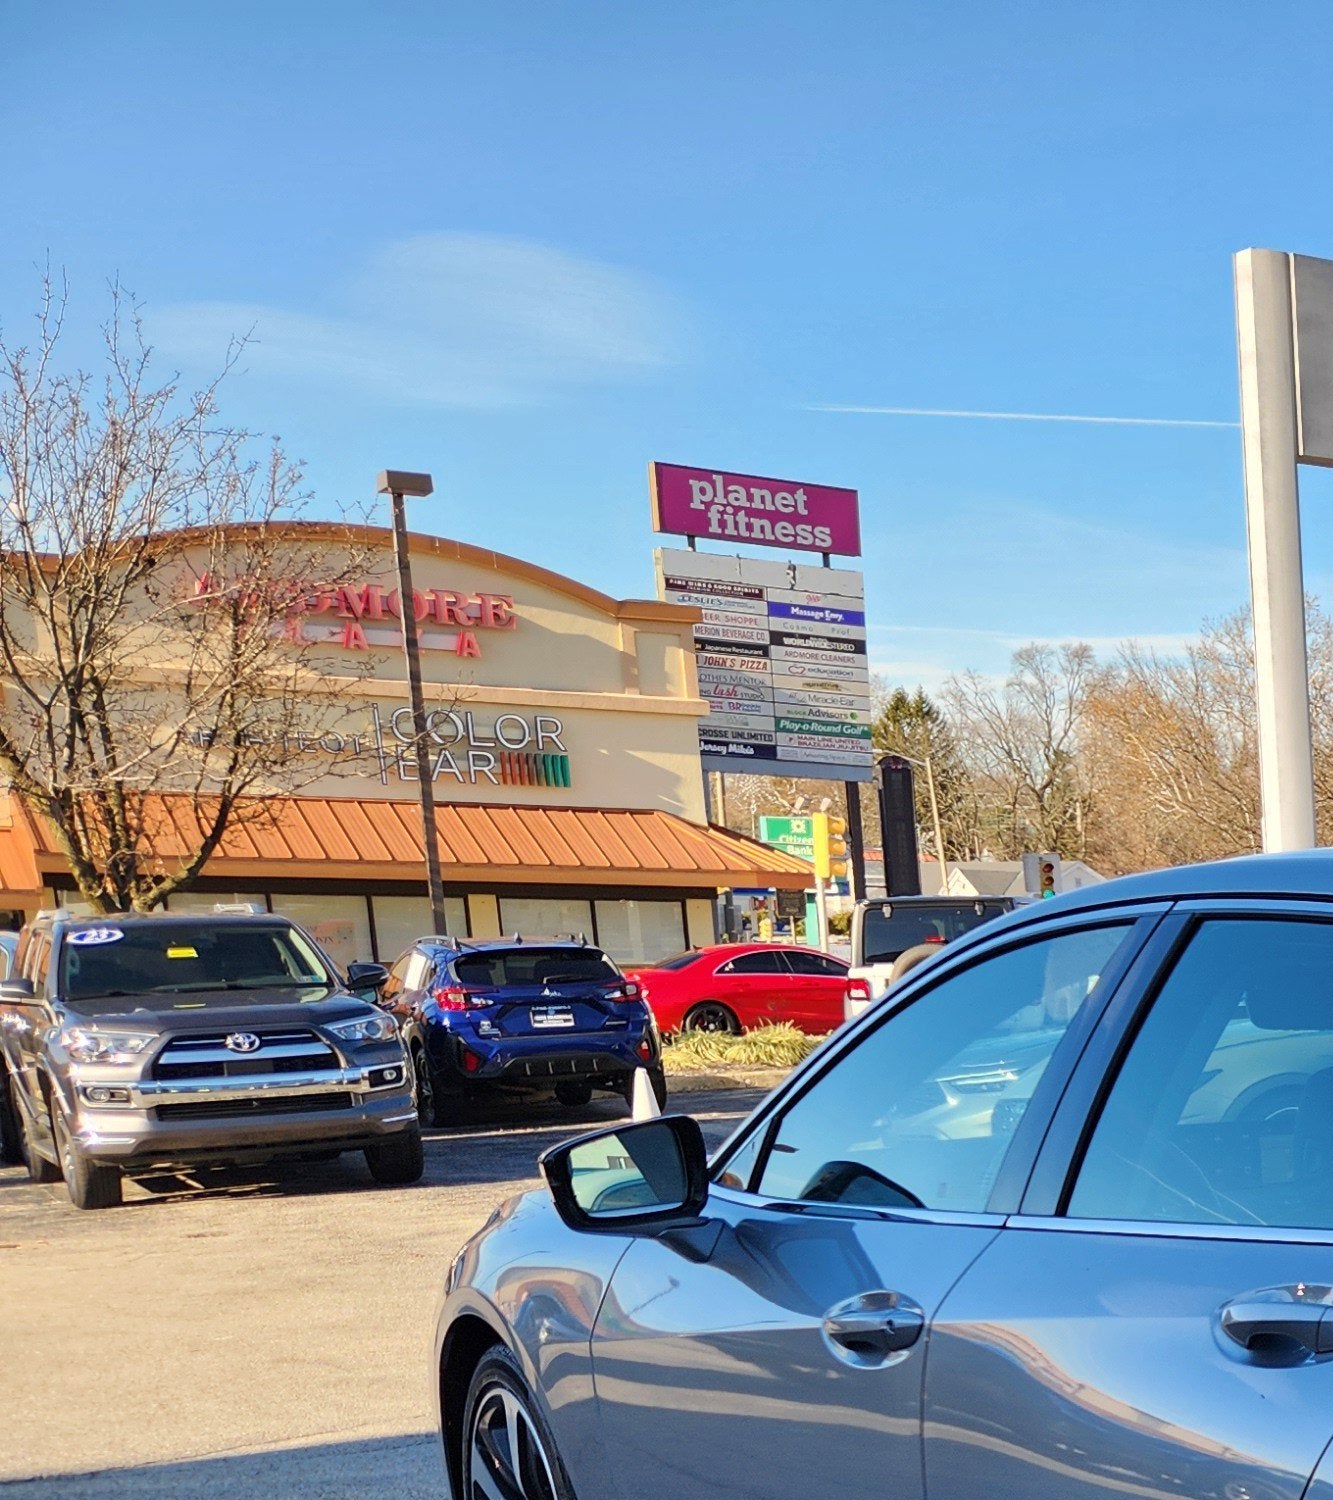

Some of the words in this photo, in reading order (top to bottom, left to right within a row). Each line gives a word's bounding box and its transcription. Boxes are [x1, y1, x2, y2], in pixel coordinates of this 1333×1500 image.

[689, 474, 809, 516] planet
[708, 504, 833, 548] fitness
[702, 613, 720, 622] EER
[725, 615, 759, 626] SHOPPE
[790, 606, 825, 620] Massage
[694, 625, 721, 637] MERION
[721, 628, 755, 641] BEVERAGE
[782, 622, 814, 632] Cosmo
[831, 627, 851, 636] Prof
[704, 643, 732, 652] Japanese
[732, 646, 764, 656] Restaurant
[703, 655, 736, 668] JOHN'S
[740, 659, 768, 671] PIZZA
[784, 650, 818, 661] ARDMORE
[820, 653, 856, 664] CLEANERS
[699, 672, 727, 683] OTHES
[807, 708, 849, 720] Advisors
[391, 706, 568, 753] COLOR
[698, 728, 729, 739] CROSSE
[731, 731, 774, 742] UNLIMITED
[700, 740, 727, 755] Jersey
[728, 743, 755, 755] Mike's
[779, 834, 814, 845] Citizen
[786, 846, 814, 856] Bank
